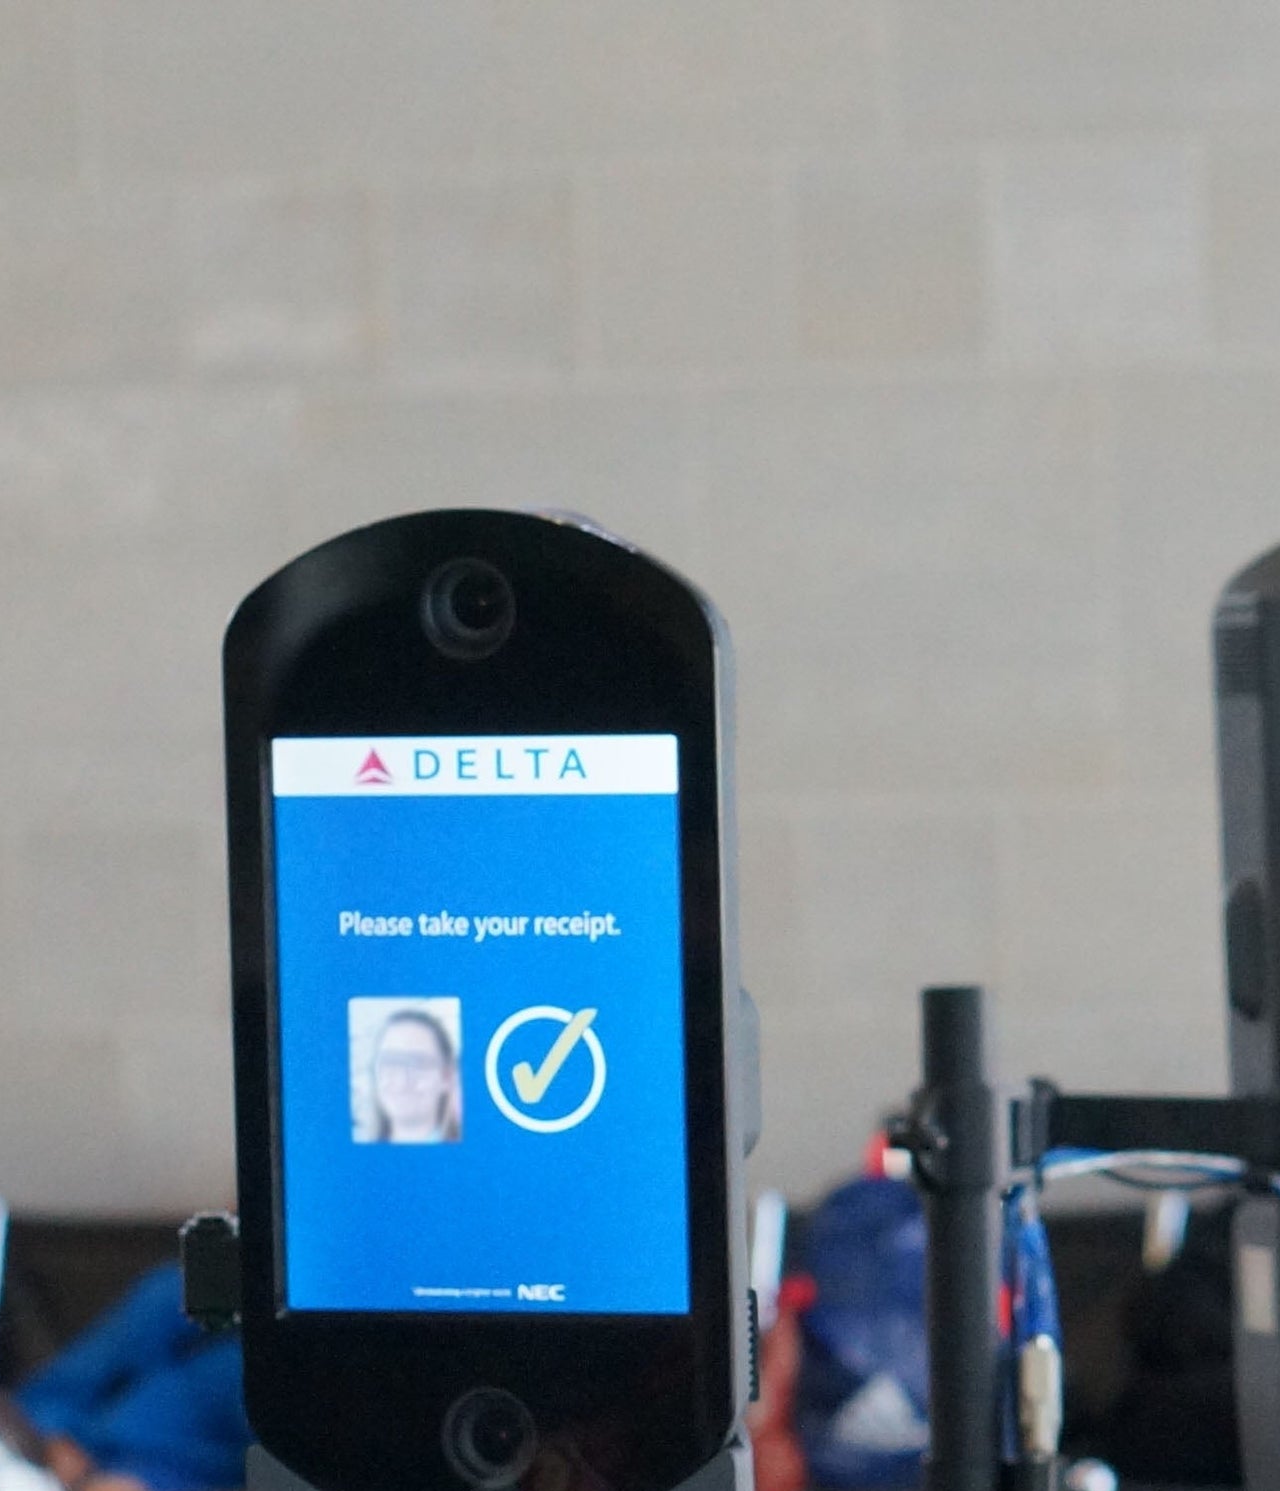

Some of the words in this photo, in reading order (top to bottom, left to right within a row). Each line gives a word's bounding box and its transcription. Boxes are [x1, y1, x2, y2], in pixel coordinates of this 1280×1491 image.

[412, 748, 587, 780] DELTA
[338, 909, 414, 937] Please
[418, 909, 470, 937] take
[472, 914, 530, 943] your
[533, 910, 621, 943] receipt.
[517, 1283, 566, 1302] NEC
